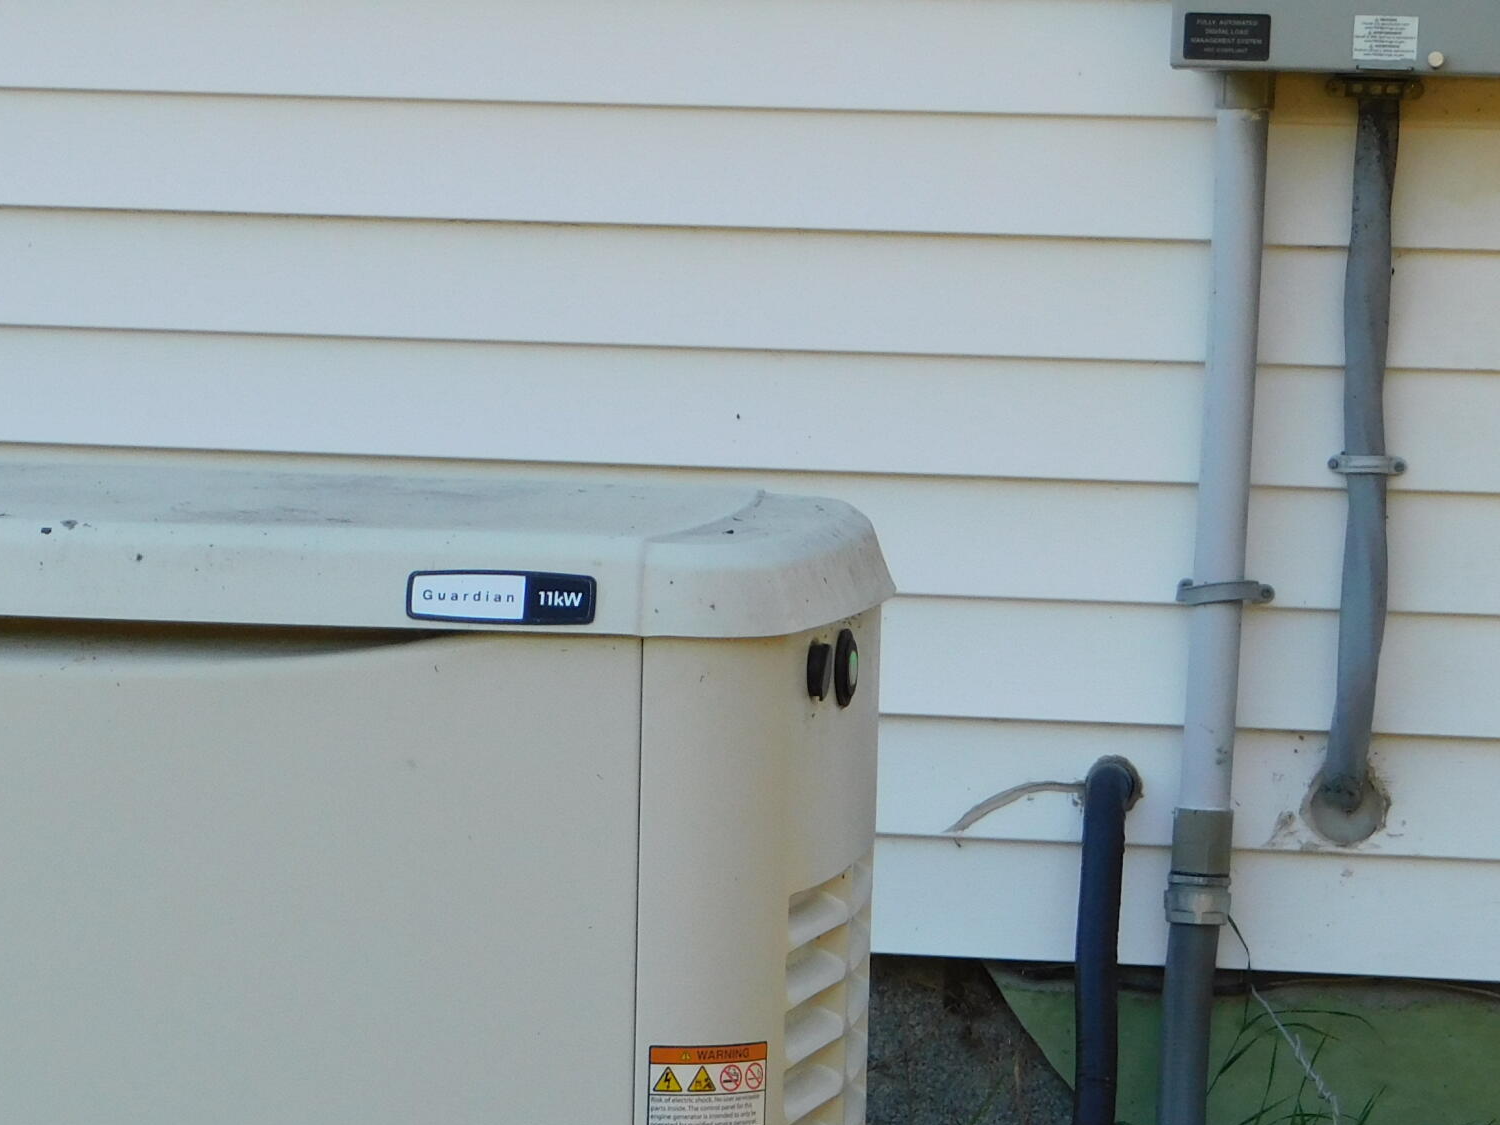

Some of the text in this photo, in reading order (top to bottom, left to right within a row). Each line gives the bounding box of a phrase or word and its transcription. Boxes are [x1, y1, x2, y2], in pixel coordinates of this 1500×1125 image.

[422, 588, 583, 607] Guardian 11kW
[696, 1048, 750, 1061] WARNING
